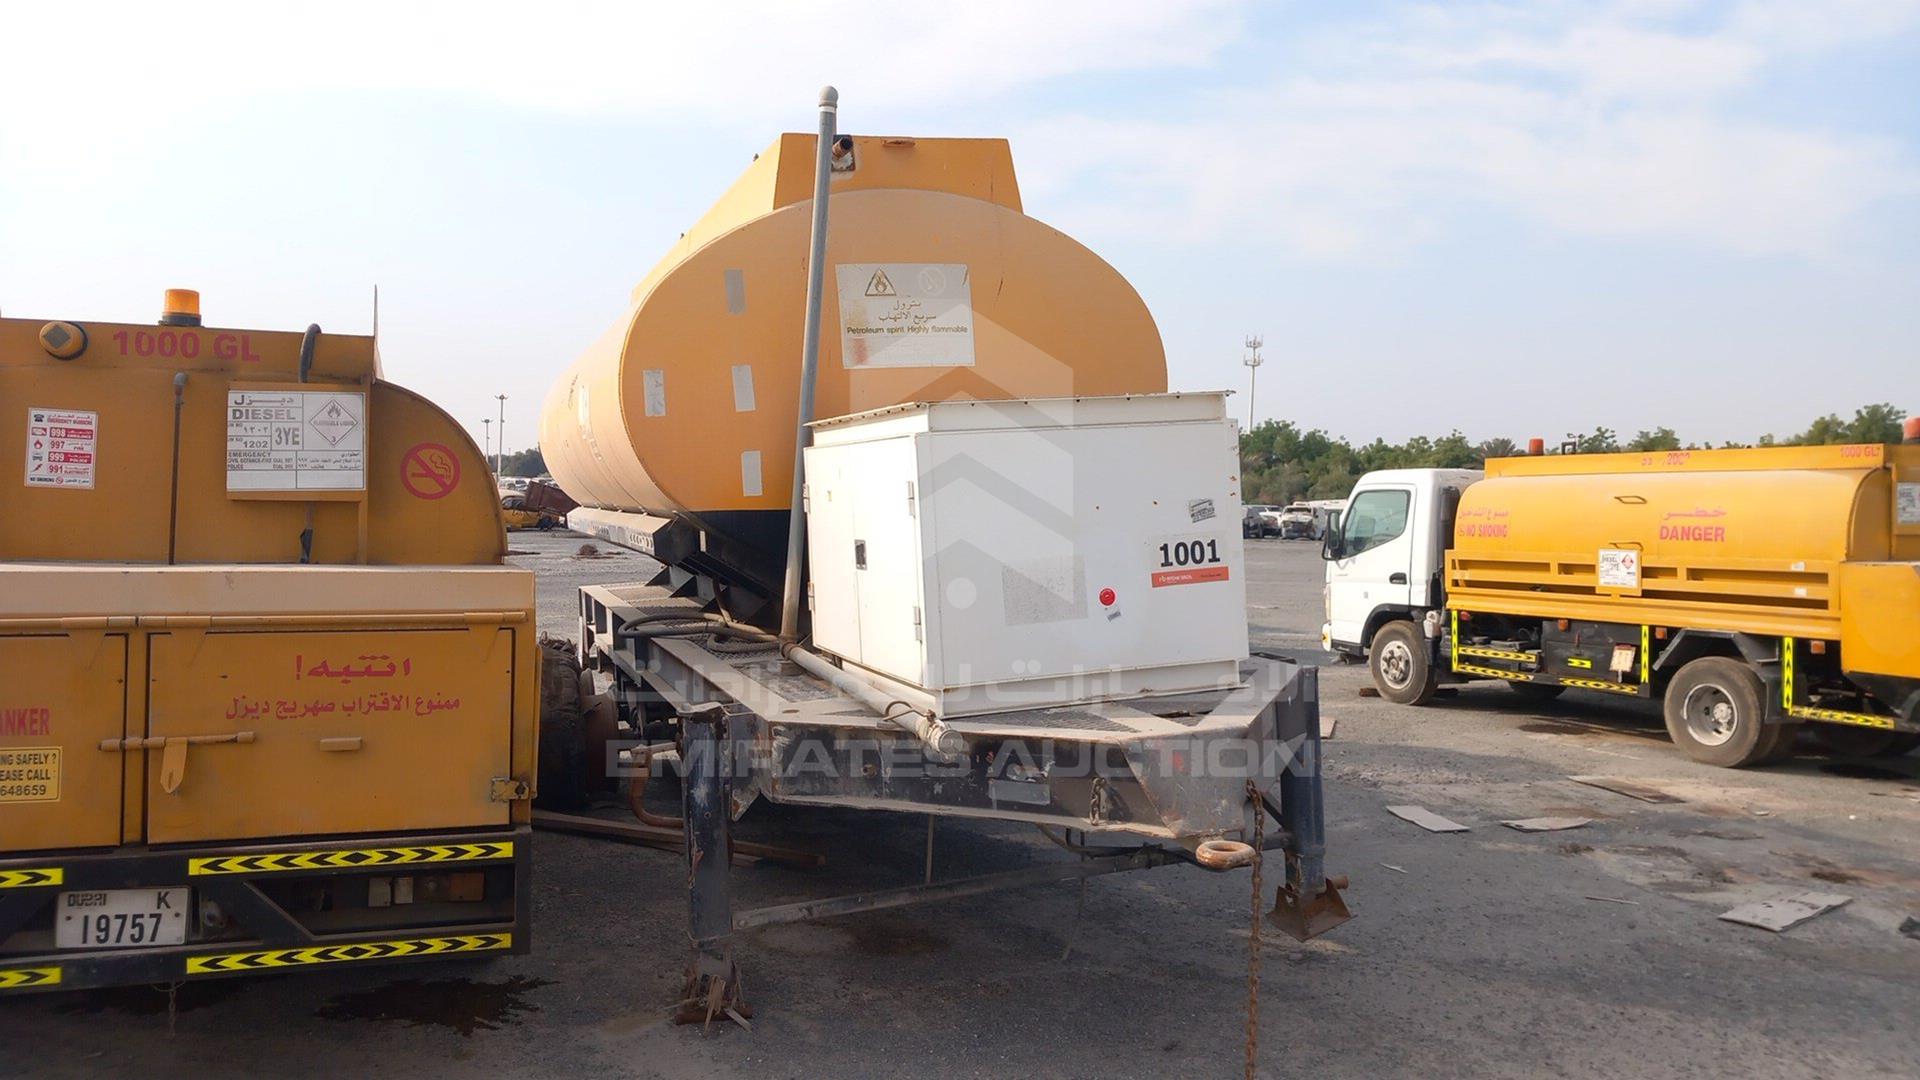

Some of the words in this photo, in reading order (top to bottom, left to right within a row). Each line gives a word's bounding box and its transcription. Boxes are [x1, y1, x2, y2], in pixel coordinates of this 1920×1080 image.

[846, 326, 885, 334] Petroleum
[112, 329, 201, 359] 1000
[212, 333, 261, 363] GL
[231, 408, 297, 420] DIESEL
[50, 428, 66, 438] 998
[274, 426, 300, 446] 3YE
[50, 440, 66, 449] 997
[243, 440, 268, 449] 1202
[49, 452, 65, 461] 999
[1840, 446, 1861, 458] 1000
[48, 465, 63, 474] 991
[1478, 524, 1508, 538] SMOKING
[1659, 526, 1726, 542] DANGER
[1159, 539, 1221, 568] 1001
[225, 695, 270, 720] ديزل
[275, 699, 336, 721] صهريج
[342, 691, 410, 717] الاقتراب
[415, 692, 461, 717] ممنوع
[16, 753, 50, 766] SAFELY
[26, 768, 51, 781] CALL
[0, 784, 47, 797] 648659
[156, 891, 172, 909] K
[81, 913, 162, 945] 19757
